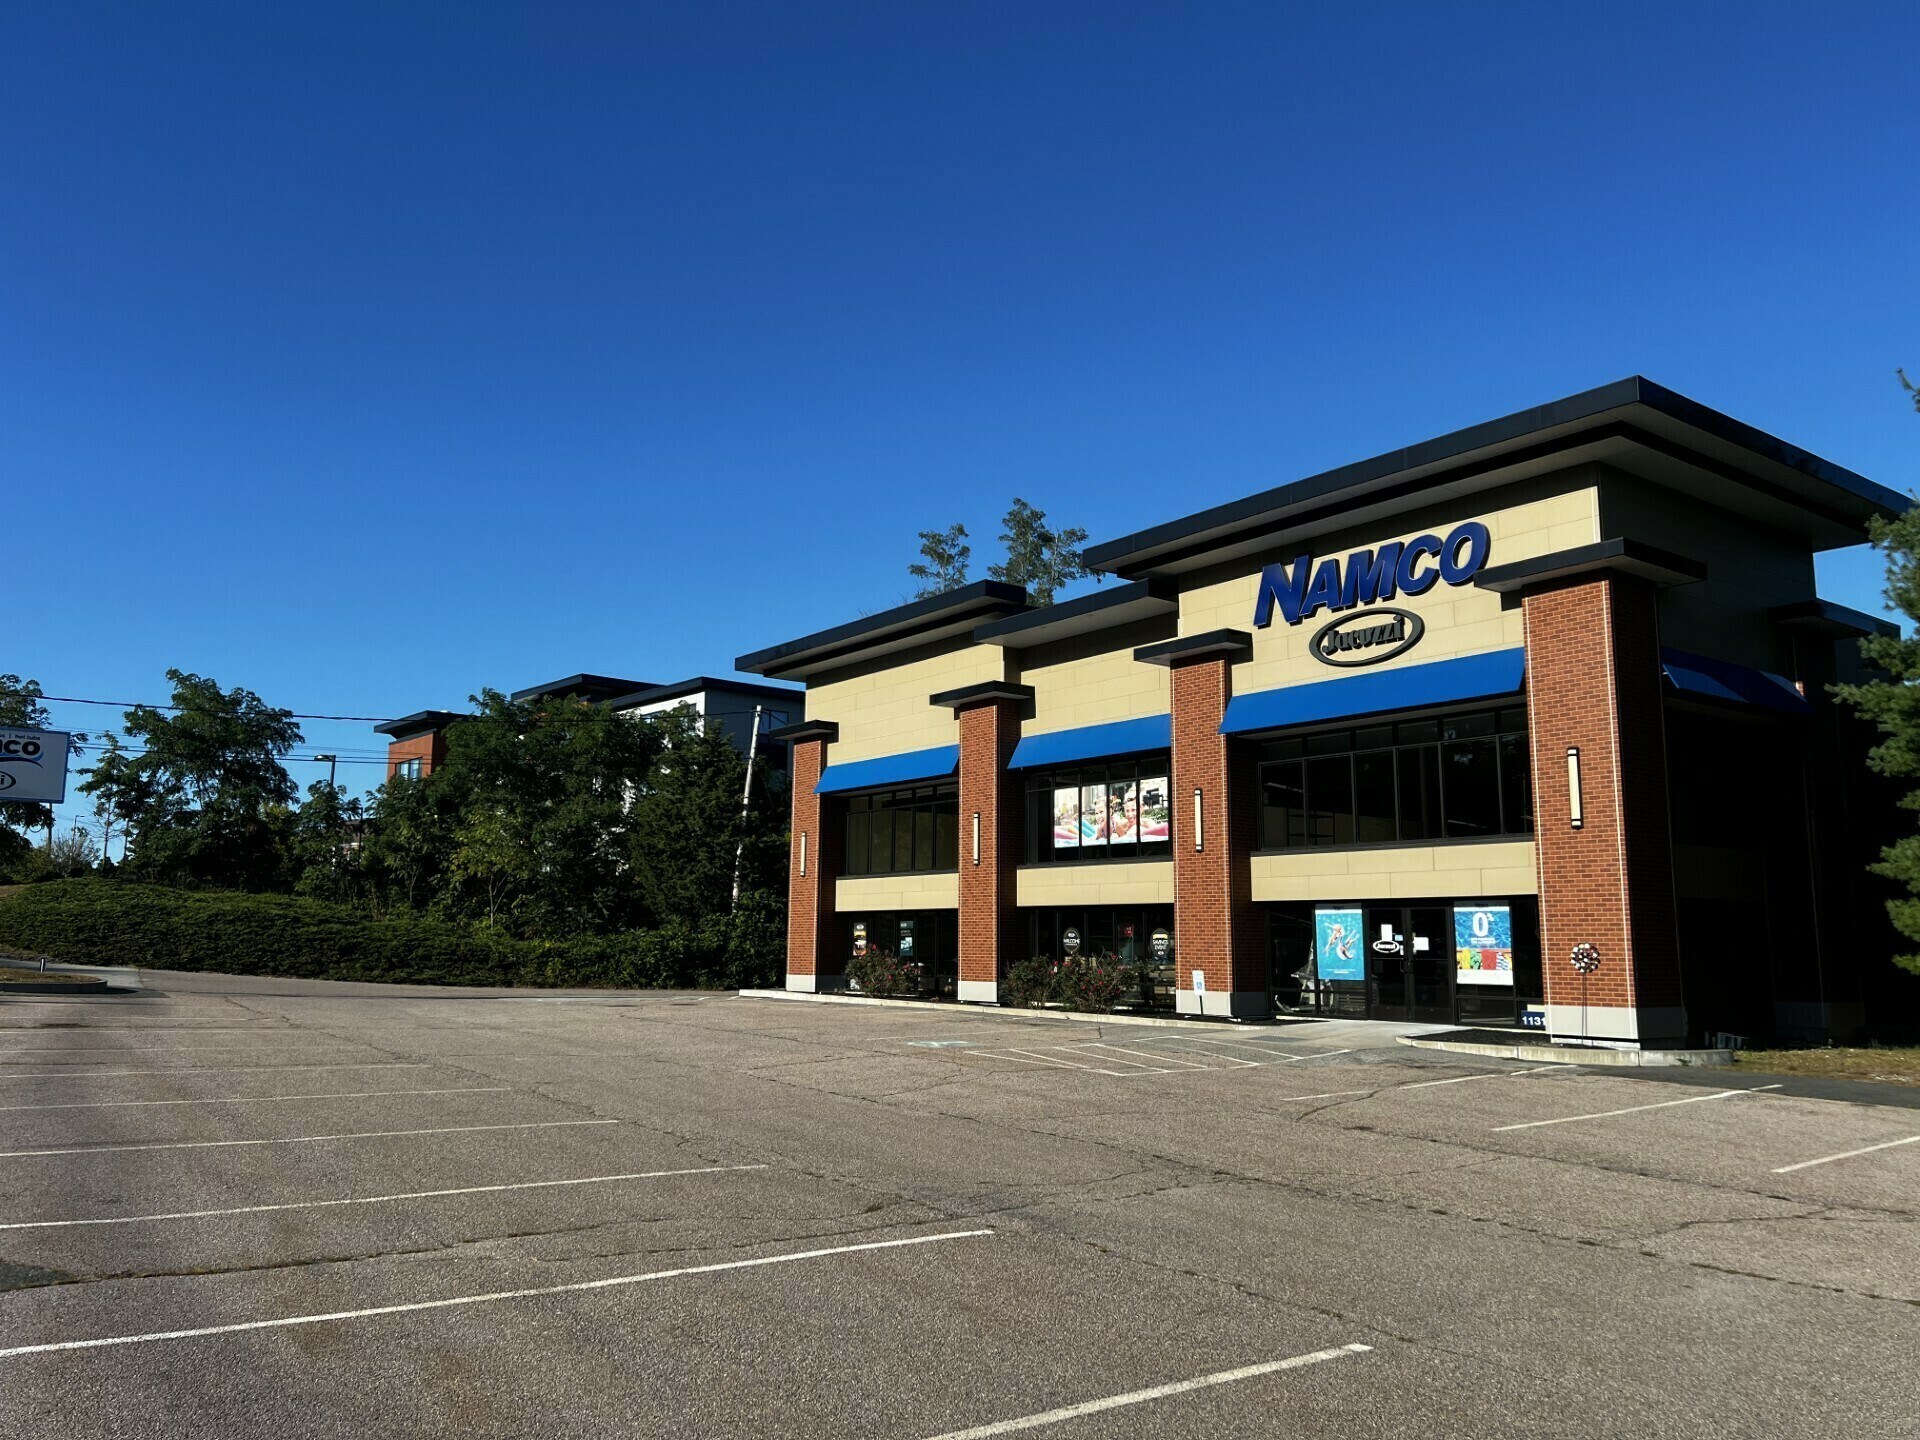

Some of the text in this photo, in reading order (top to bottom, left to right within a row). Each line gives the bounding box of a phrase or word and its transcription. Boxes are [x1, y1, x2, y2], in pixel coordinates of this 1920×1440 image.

[1253, 522, 1491, 629] NAMCO
[1322, 614, 1406, 656] Jacuzzi
[0, 739, 41, 756] CO
